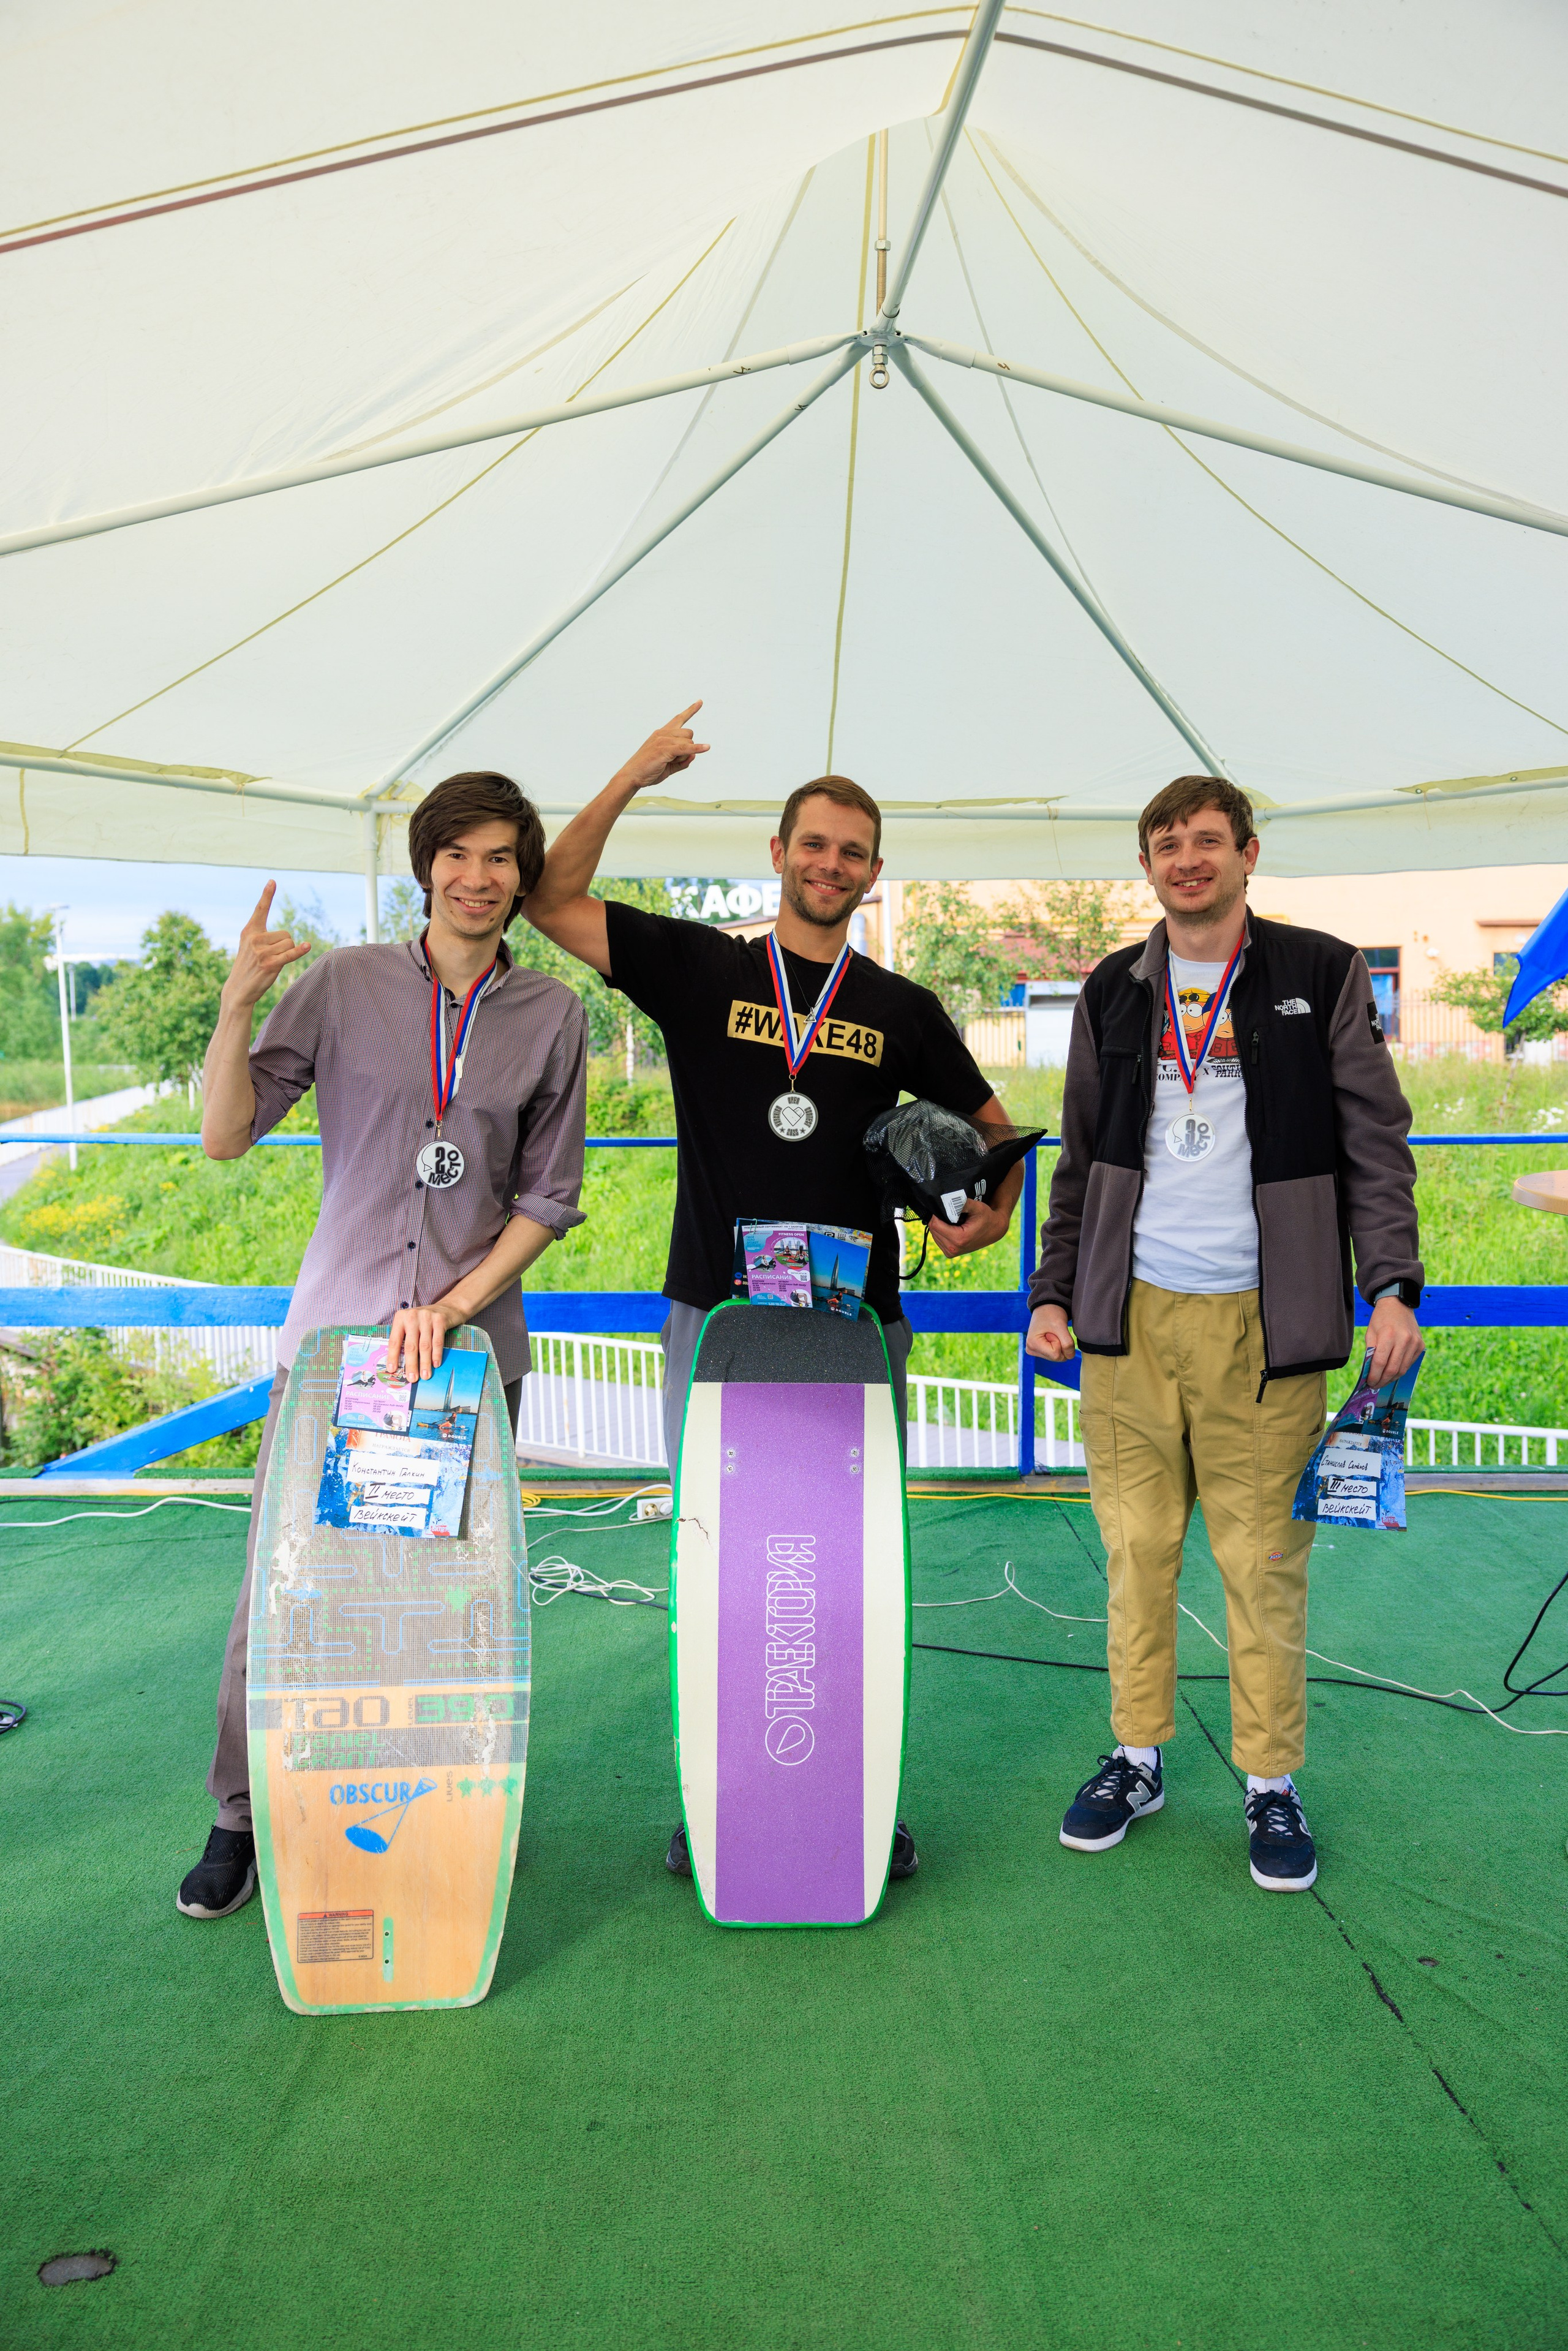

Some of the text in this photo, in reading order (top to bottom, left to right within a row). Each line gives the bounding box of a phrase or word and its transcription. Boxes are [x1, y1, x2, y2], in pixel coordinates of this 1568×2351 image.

[670, 883, 782, 918] КАФЕ
[1156, 1073, 1199, 1082] OMPY
[1185, 1119, 1196, 1146] 3
[435, 1146, 445, 1174] 2
[835, 1308, 852, 1316] DOUBLE
[345, 1391, 390, 1400] РАСПИСАНИЕ
[372, 1443, 410, 1452] НАГРАЖДАЕТСЯ
[766, 1535, 816, 1719] ТРАЕКТОРИЯ
